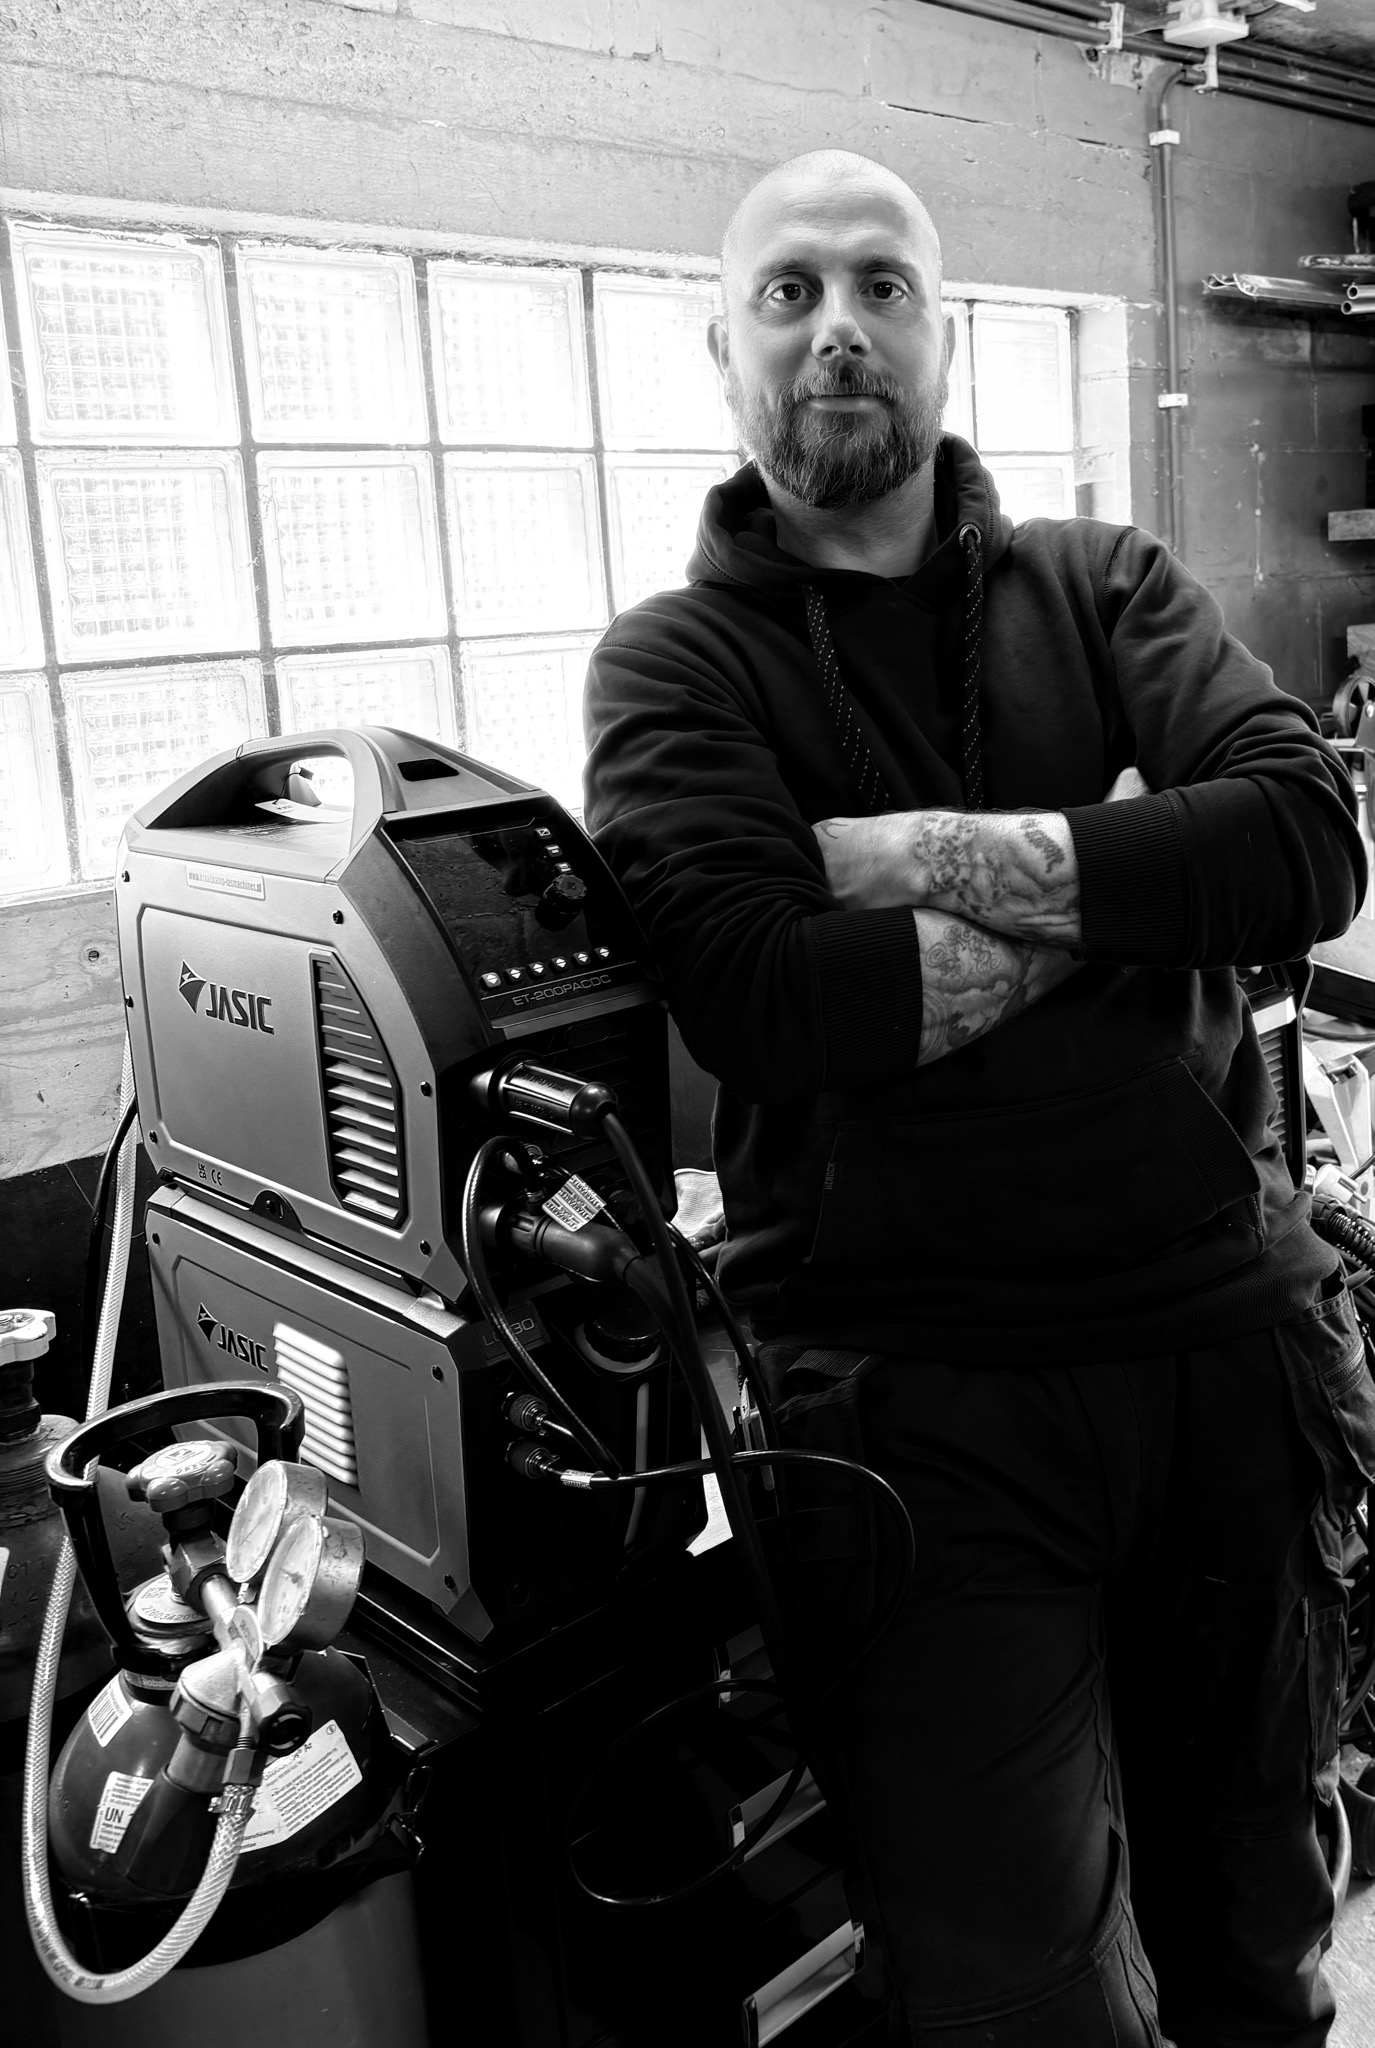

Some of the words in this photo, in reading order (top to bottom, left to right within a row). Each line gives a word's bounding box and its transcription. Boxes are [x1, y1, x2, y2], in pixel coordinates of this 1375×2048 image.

[205, 982, 275, 1035] JASIC
[511, 974, 612, 1007] ET-200PACDC
[217, 1324, 269, 1374] JASIC
[105, 1806, 125, 1824] UN
